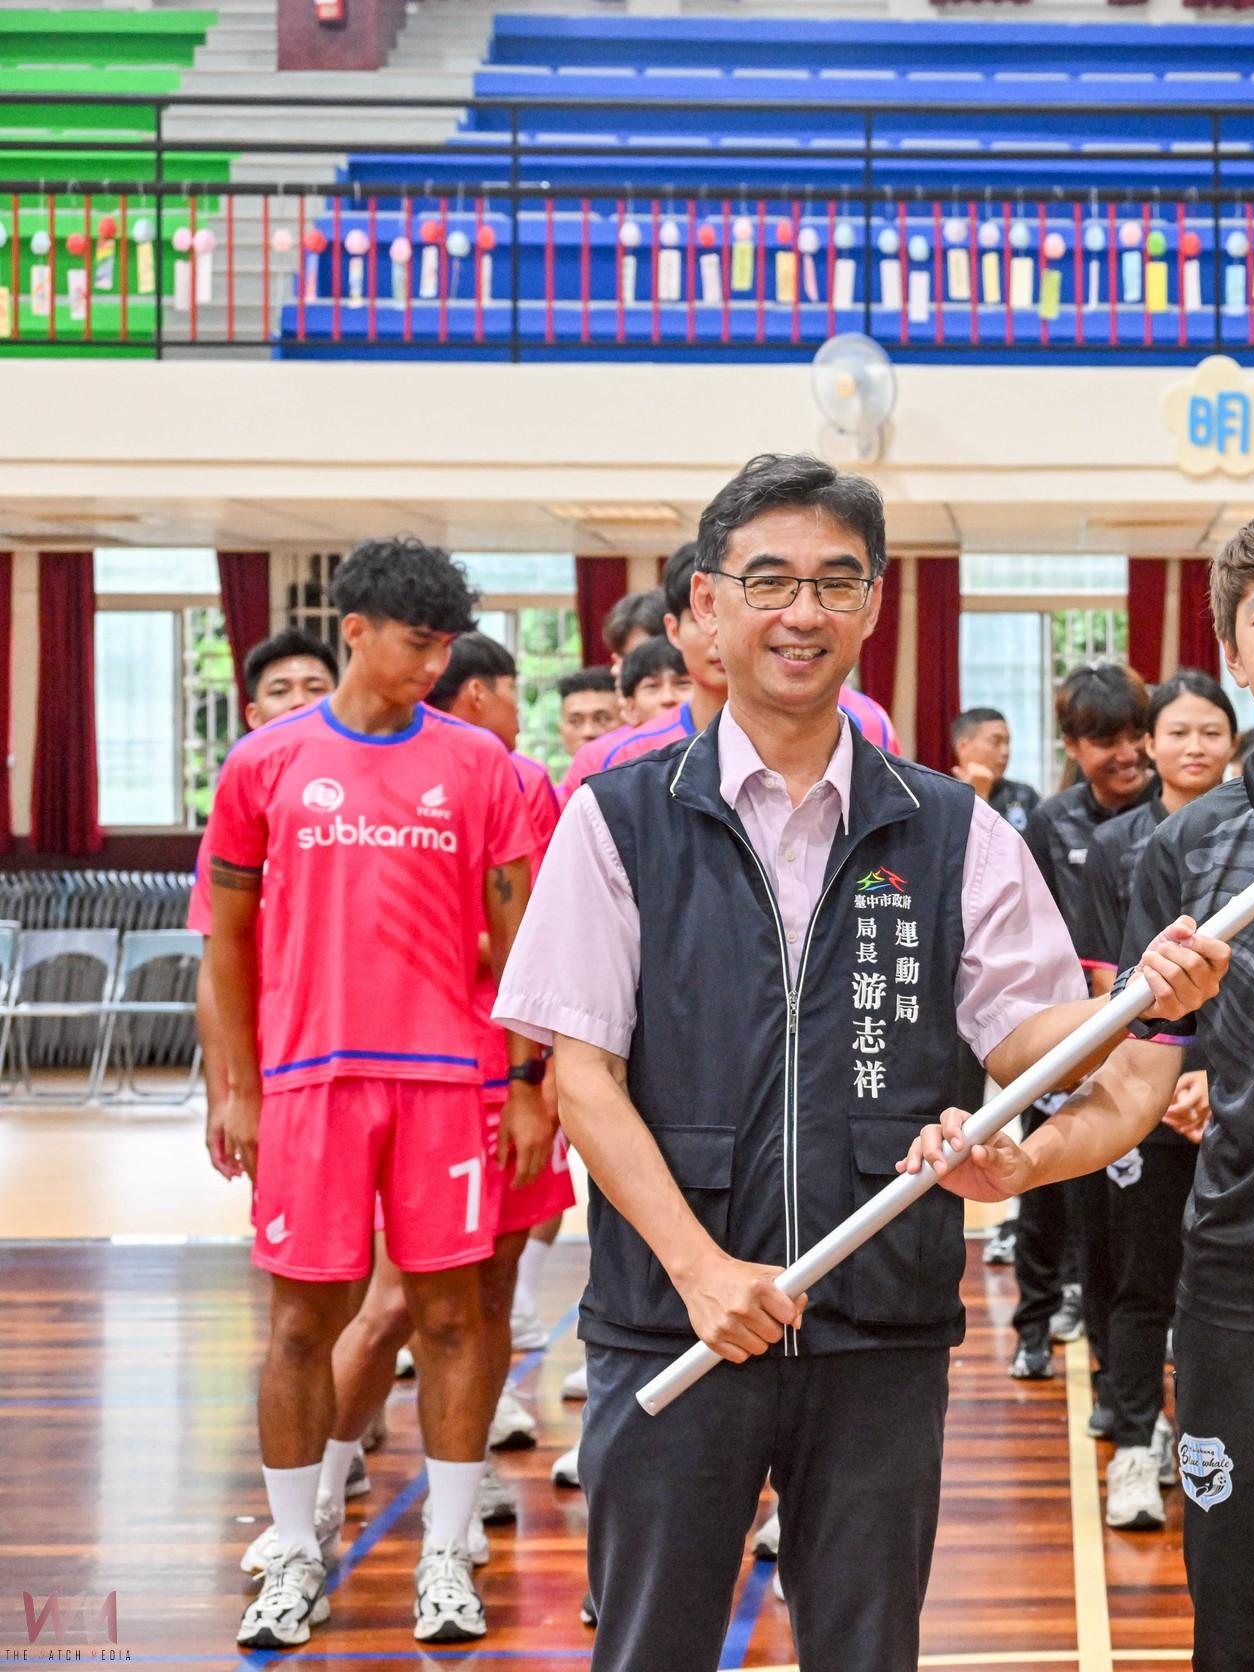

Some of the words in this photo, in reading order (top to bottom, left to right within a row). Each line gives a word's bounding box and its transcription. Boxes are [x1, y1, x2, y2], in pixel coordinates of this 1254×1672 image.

[1188, 391, 1252, 456] 明
[297, 815, 457, 854] subkarma
[854, 893, 912, 910] 臺中市政府
[894, 918, 921, 1024] 運動局
